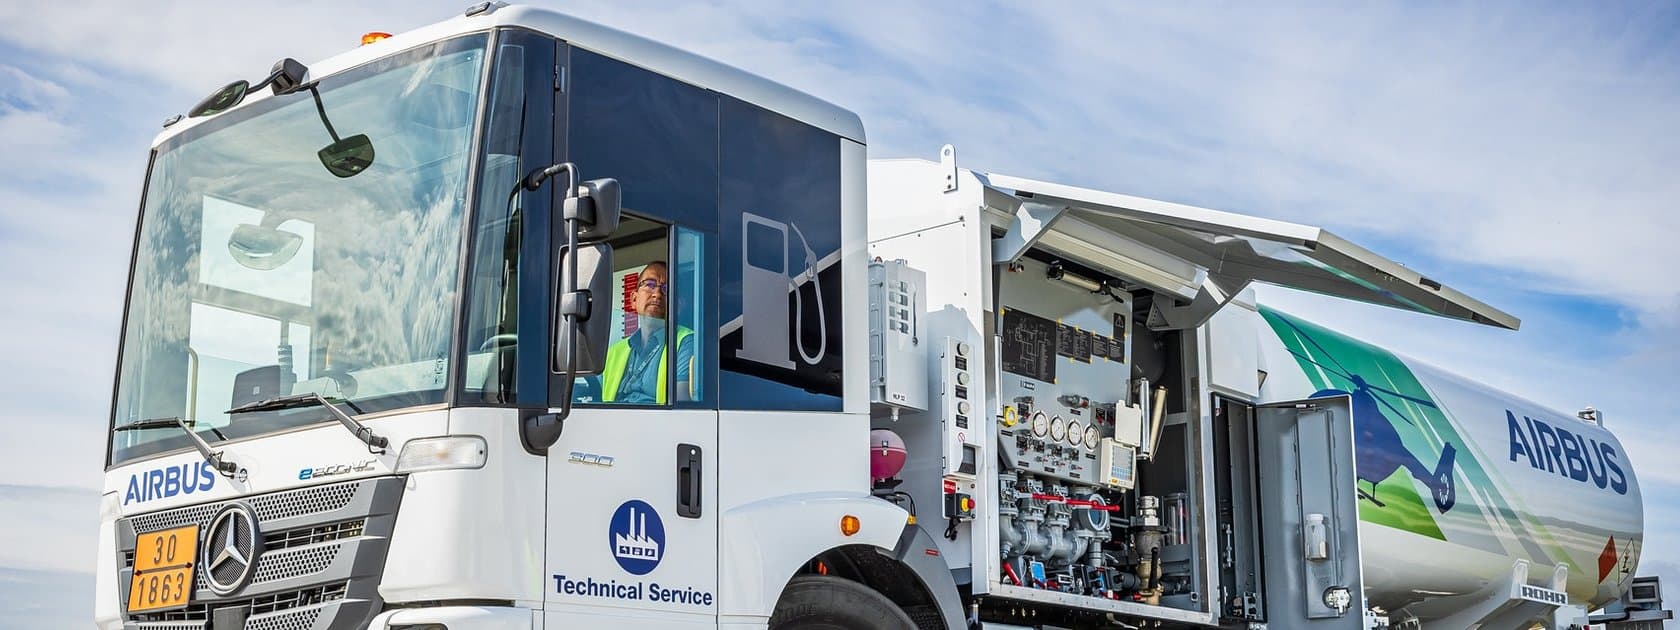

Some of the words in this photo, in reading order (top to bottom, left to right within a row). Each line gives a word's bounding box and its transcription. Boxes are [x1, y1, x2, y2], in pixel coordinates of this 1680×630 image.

[1505, 408, 1628, 495] AIRBUS
[124, 460, 215, 505] AIRBUS
[153, 534, 177, 564] 30
[137, 572, 185, 607] 1863
[553, 575, 642, 600] Technical
[649, 583, 713, 606] Service
[1522, 586, 1566, 604] ROHR
